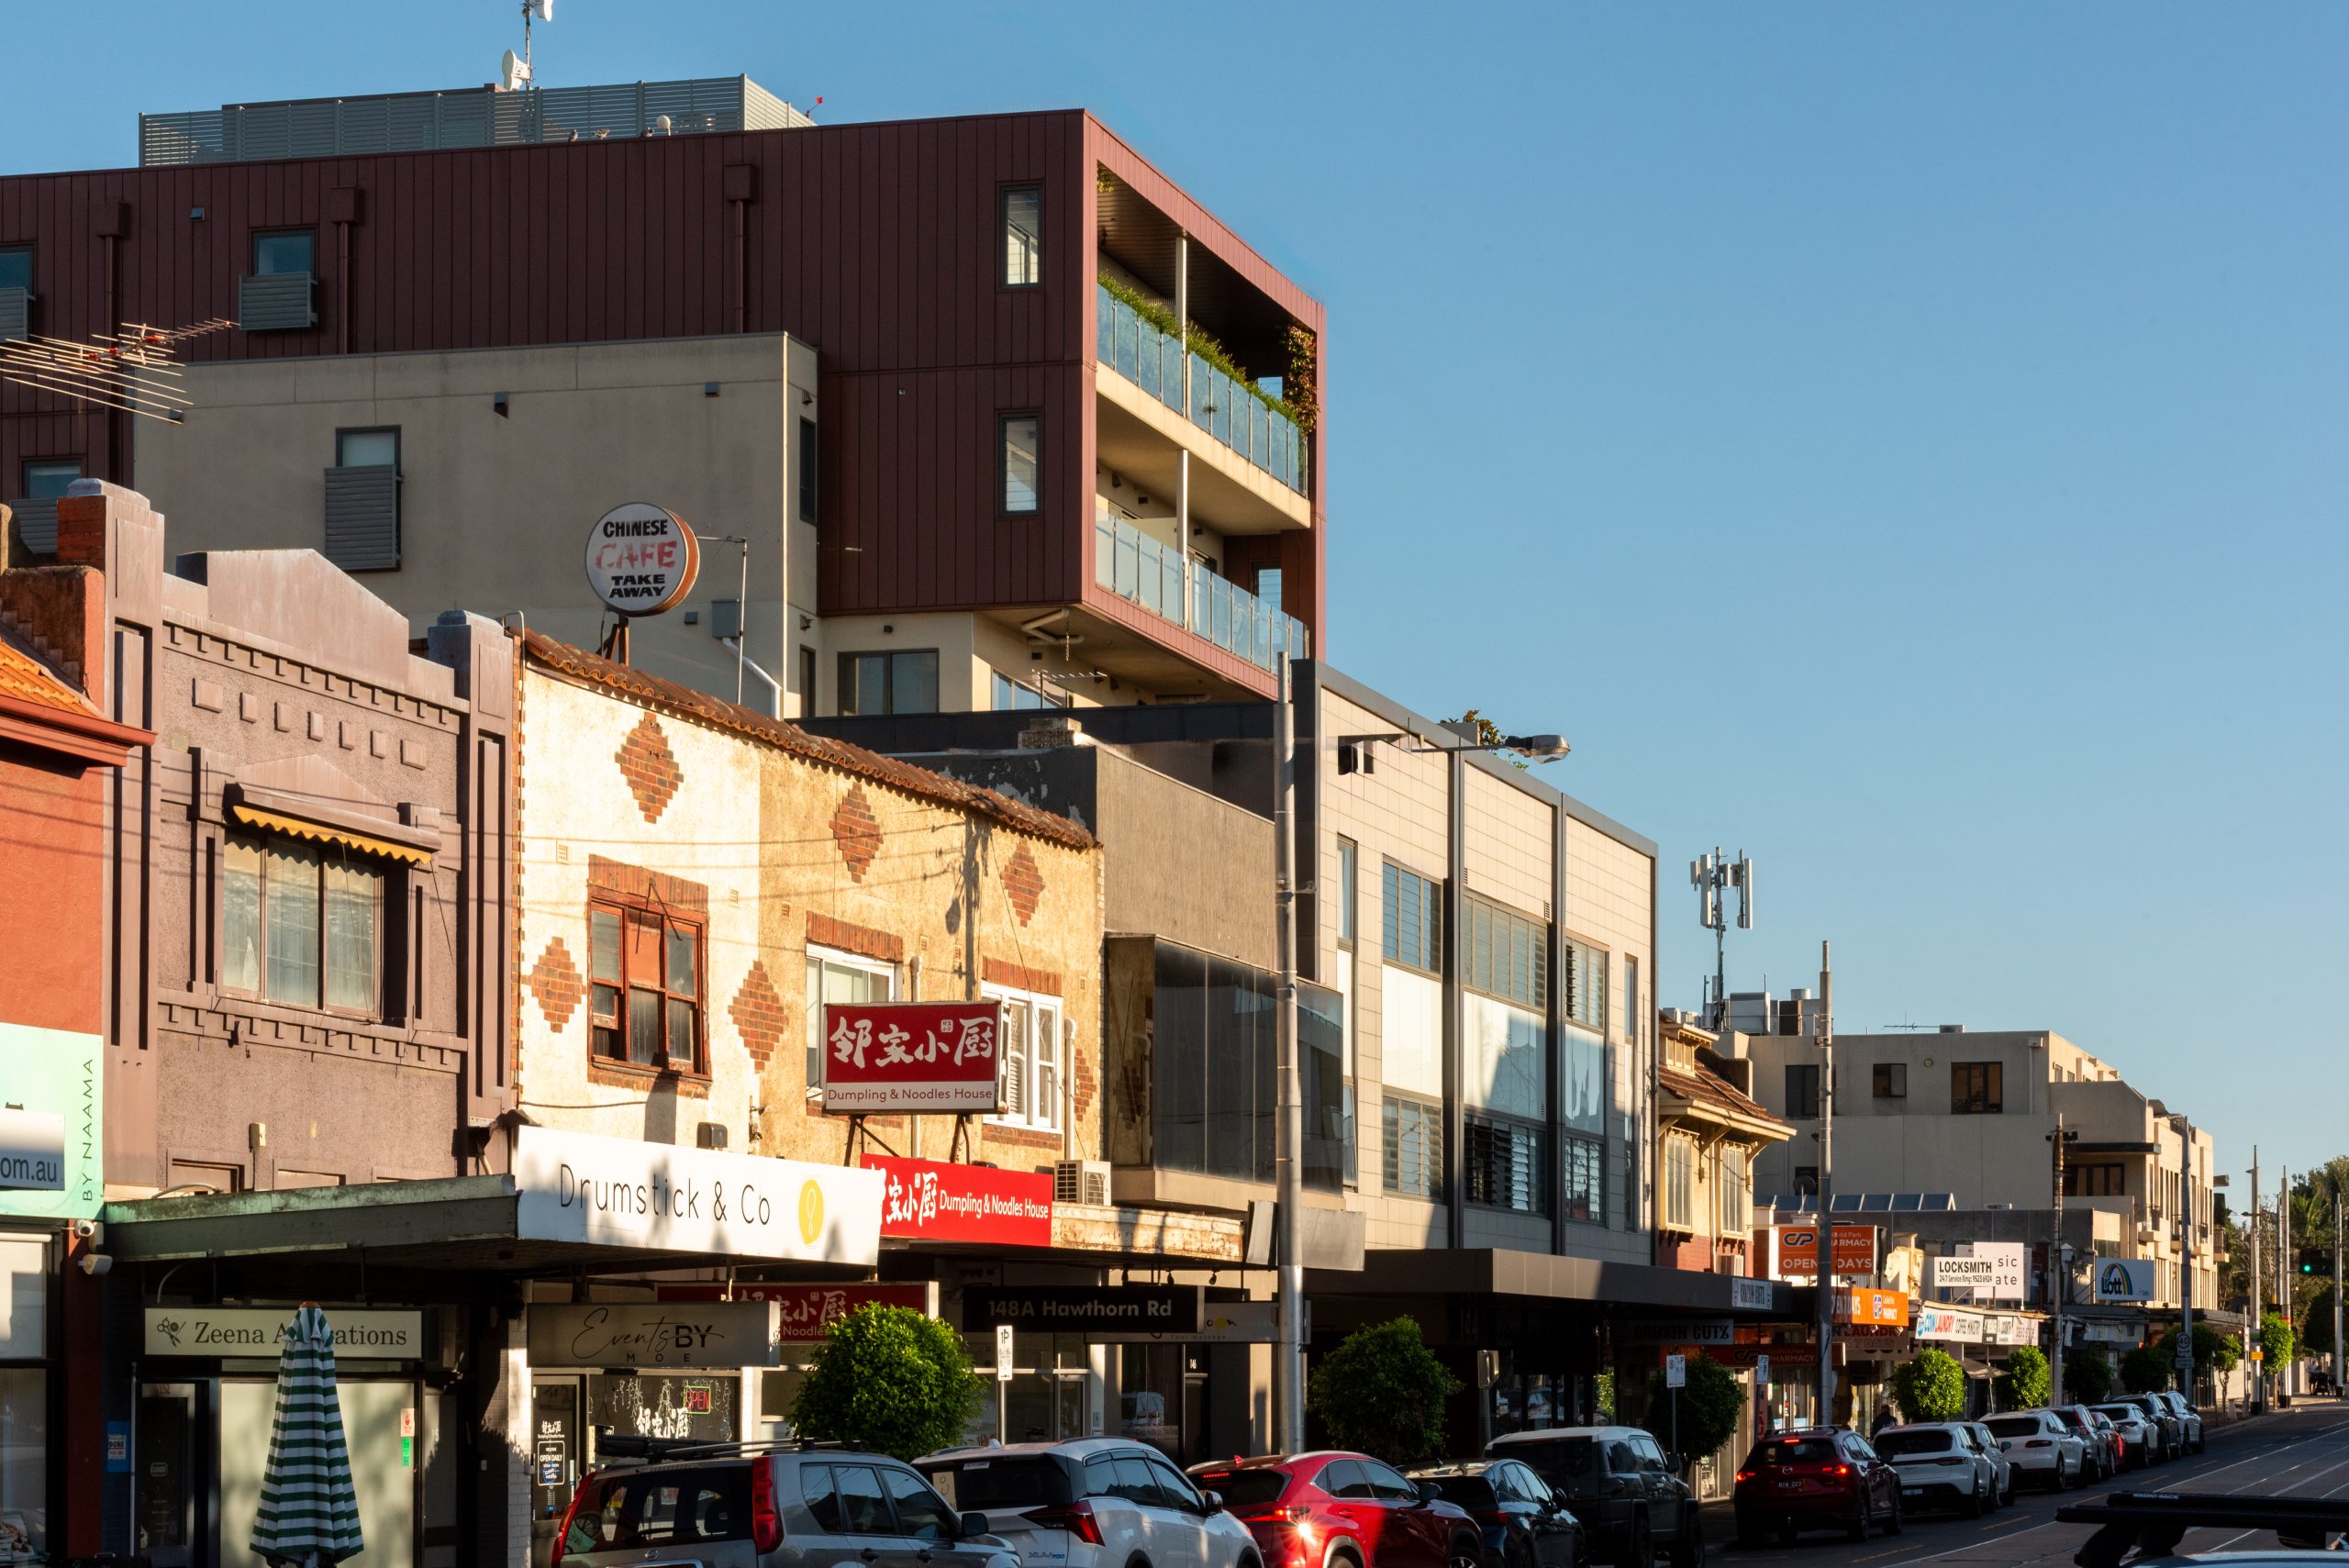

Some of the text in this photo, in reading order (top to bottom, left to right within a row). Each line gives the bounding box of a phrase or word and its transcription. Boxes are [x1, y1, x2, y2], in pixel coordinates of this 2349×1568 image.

[603, 518, 668, 538] CHINESE
[595, 539, 677, 570] CAFE
[611, 573, 665, 585] TAKE
[609, 586, 665, 598] AWAY
[829, 1016, 995, 1069] 邻家小厨
[828, 1088, 992, 1103] Dumpling & Noodles House
[83, 1059, 93, 1201] BY NAAMA
[560, 1163, 770, 1225] Drumstick & Co
[940, 1189, 1049, 1218] Dumpling & Noodles House
[1831, 1239, 1872, 1247] ARMACY
[1838, 1258, 1873, 1269] DAYS
[1939, 1261, 1992, 1273] LOCKSMITH
[2101, 1276, 2121, 1295] Lott
[987, 1299, 1173, 1317] 148A Hawthorn Rd
[195, 1321, 264, 1344] Zeena
[572, 1307, 713, 1359] Events BY
[783, 1326, 829, 1337] Noodle
[2178, 1337, 2188, 1345] 40
[685, 1390, 709, 1410] OPEN
[540, 1454, 551, 1462] OPEN
